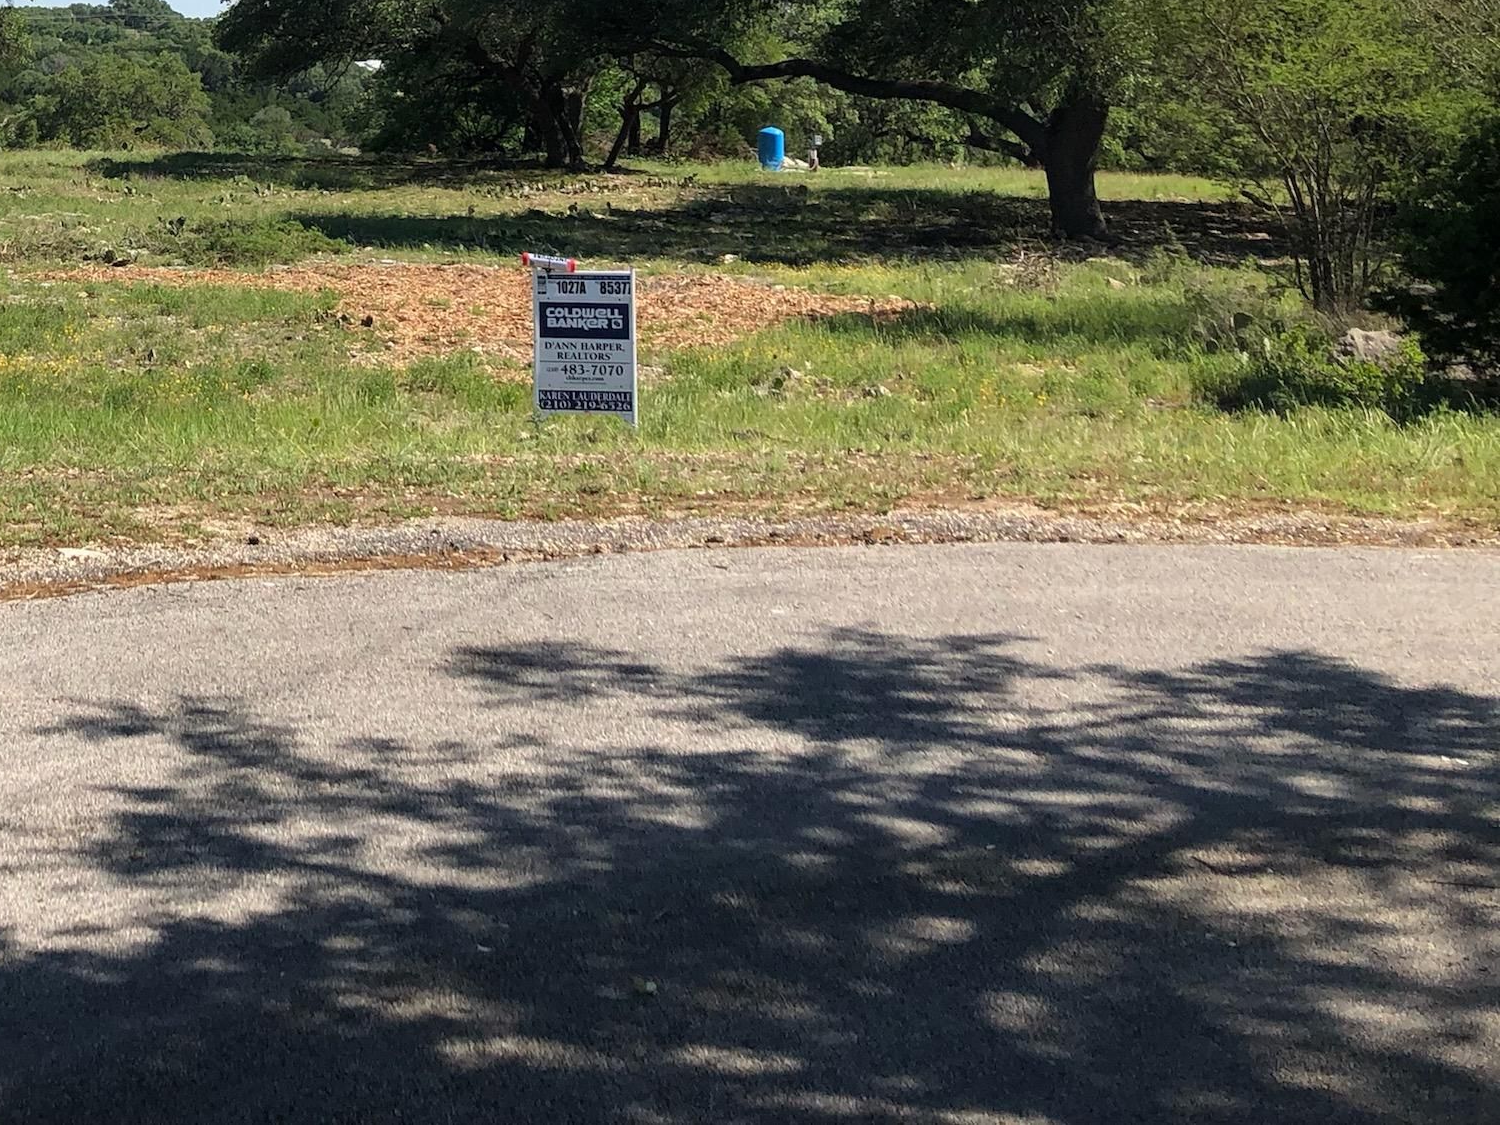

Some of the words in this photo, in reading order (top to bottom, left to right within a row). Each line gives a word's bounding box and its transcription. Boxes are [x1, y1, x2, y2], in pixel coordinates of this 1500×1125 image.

[557, 281, 587, 294] 1027A
[546, 307, 623, 318] COLDWELL
[547, 318, 608, 330] BANKER
[545, 342, 578, 350] D'ANN
[581, 342, 625, 352] HARPER,
[561, 364, 624, 376] 483-7070
[540, 391, 569, 400] KAREN
[572, 392, 630, 401] LAUDERDALE
[541, 400, 570, 409] (210)
